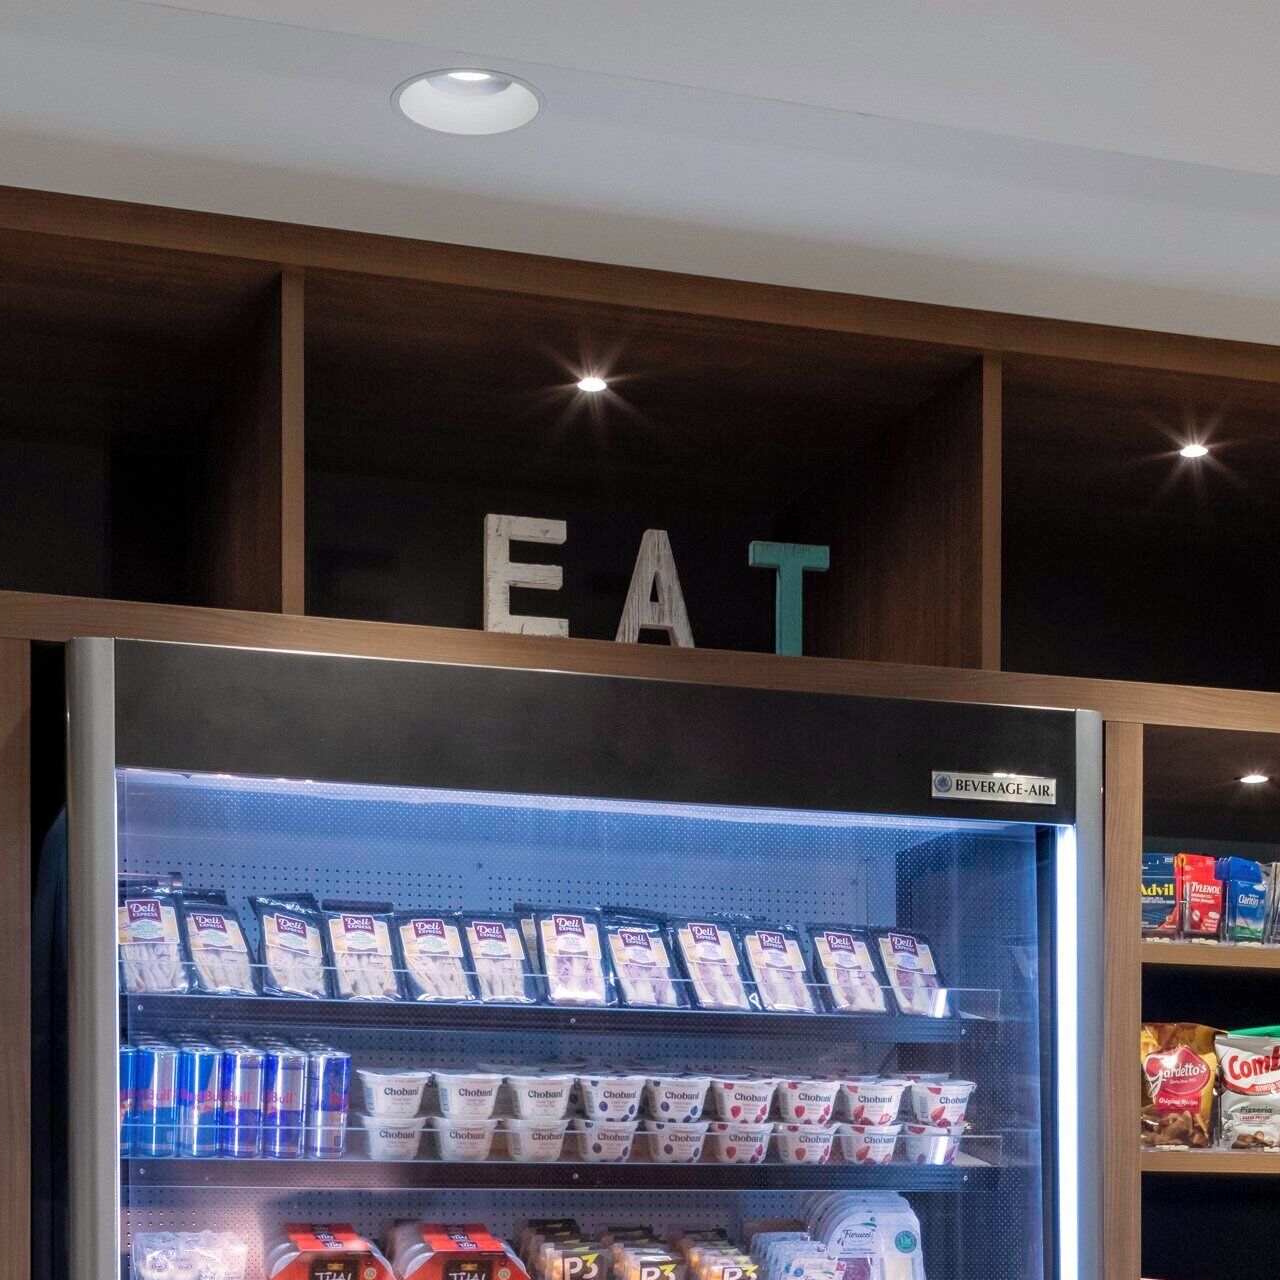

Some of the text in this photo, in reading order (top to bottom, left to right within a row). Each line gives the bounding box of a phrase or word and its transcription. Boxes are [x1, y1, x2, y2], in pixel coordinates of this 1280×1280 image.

[483, 513, 830, 656] EAT
[956, 779, 1050, 796] BEVERAGE-AIR
[1141, 883, 1174, 895] Advil
[1191, 882, 1220, 894] TYLENOL
[130, 903, 155, 913] Deli
[555, 918, 579, 927] Deli
[384, 1087, 419, 1096] Chobani
[527, 1089, 563, 1099] Chobani
[603, 1091, 637, 1099] Chobani
[1240, 1106, 1273, 1114] Pizzeria
[843, 1229, 873, 1240] Fiorucci
